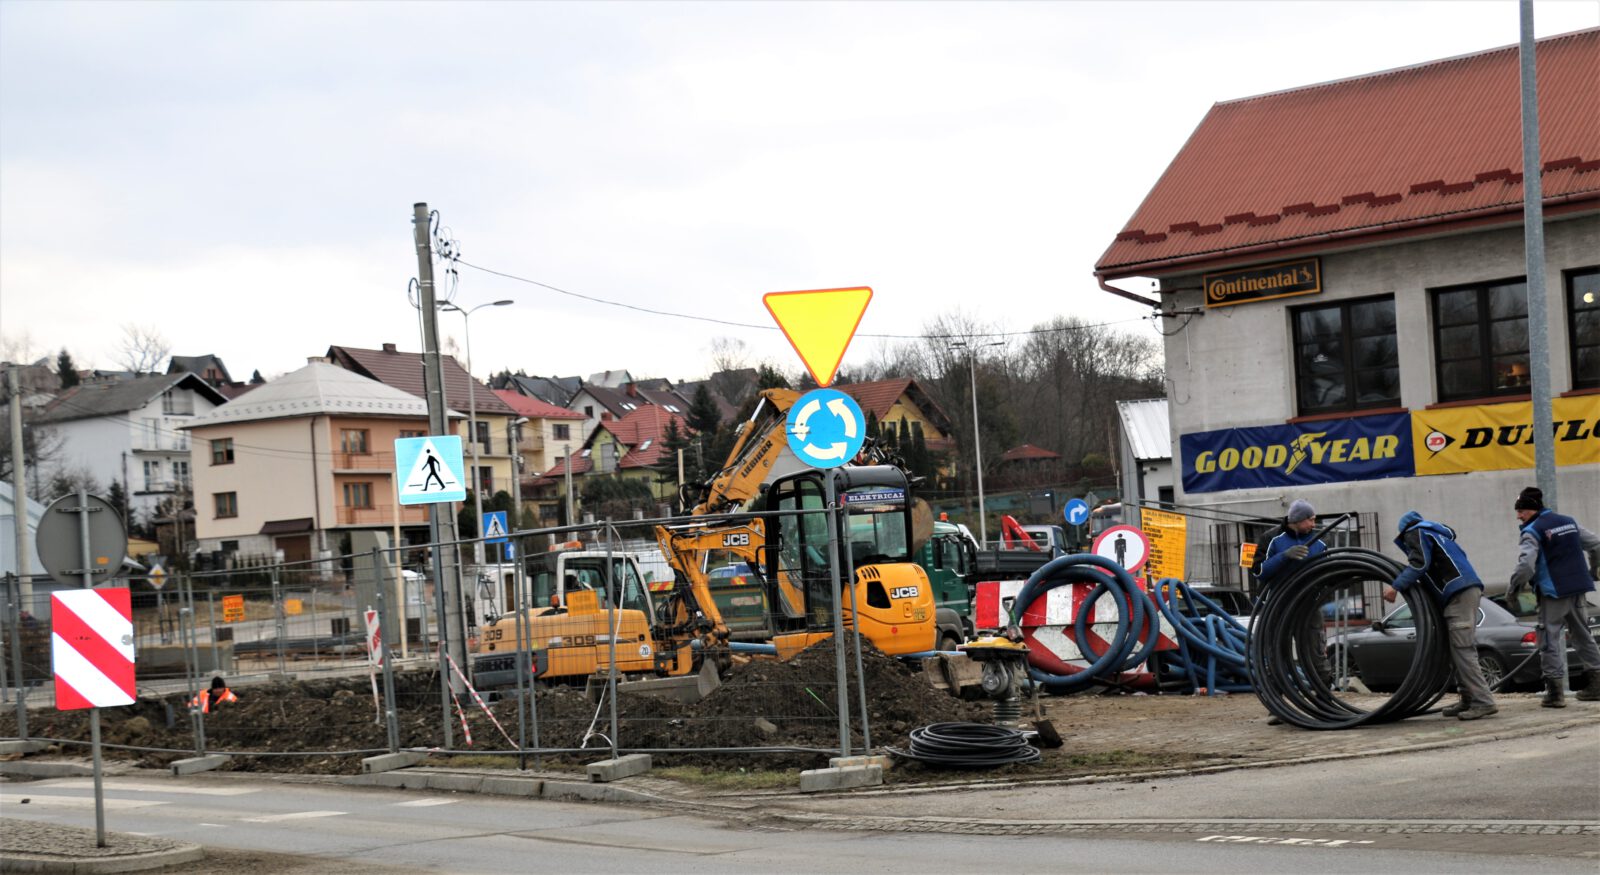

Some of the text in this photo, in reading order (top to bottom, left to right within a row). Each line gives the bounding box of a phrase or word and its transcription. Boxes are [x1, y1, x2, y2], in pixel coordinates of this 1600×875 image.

[1209, 269, 1298, 300] Continental
[741, 440, 773, 478] LIEBHERR
[848, 492, 904, 502] ELEKTRICAL
[723, 533, 749, 547] JCB
[891, 586, 918, 599] JCB
[562, 635, 595, 647] 309
[641, 645, 649, 656] 20
